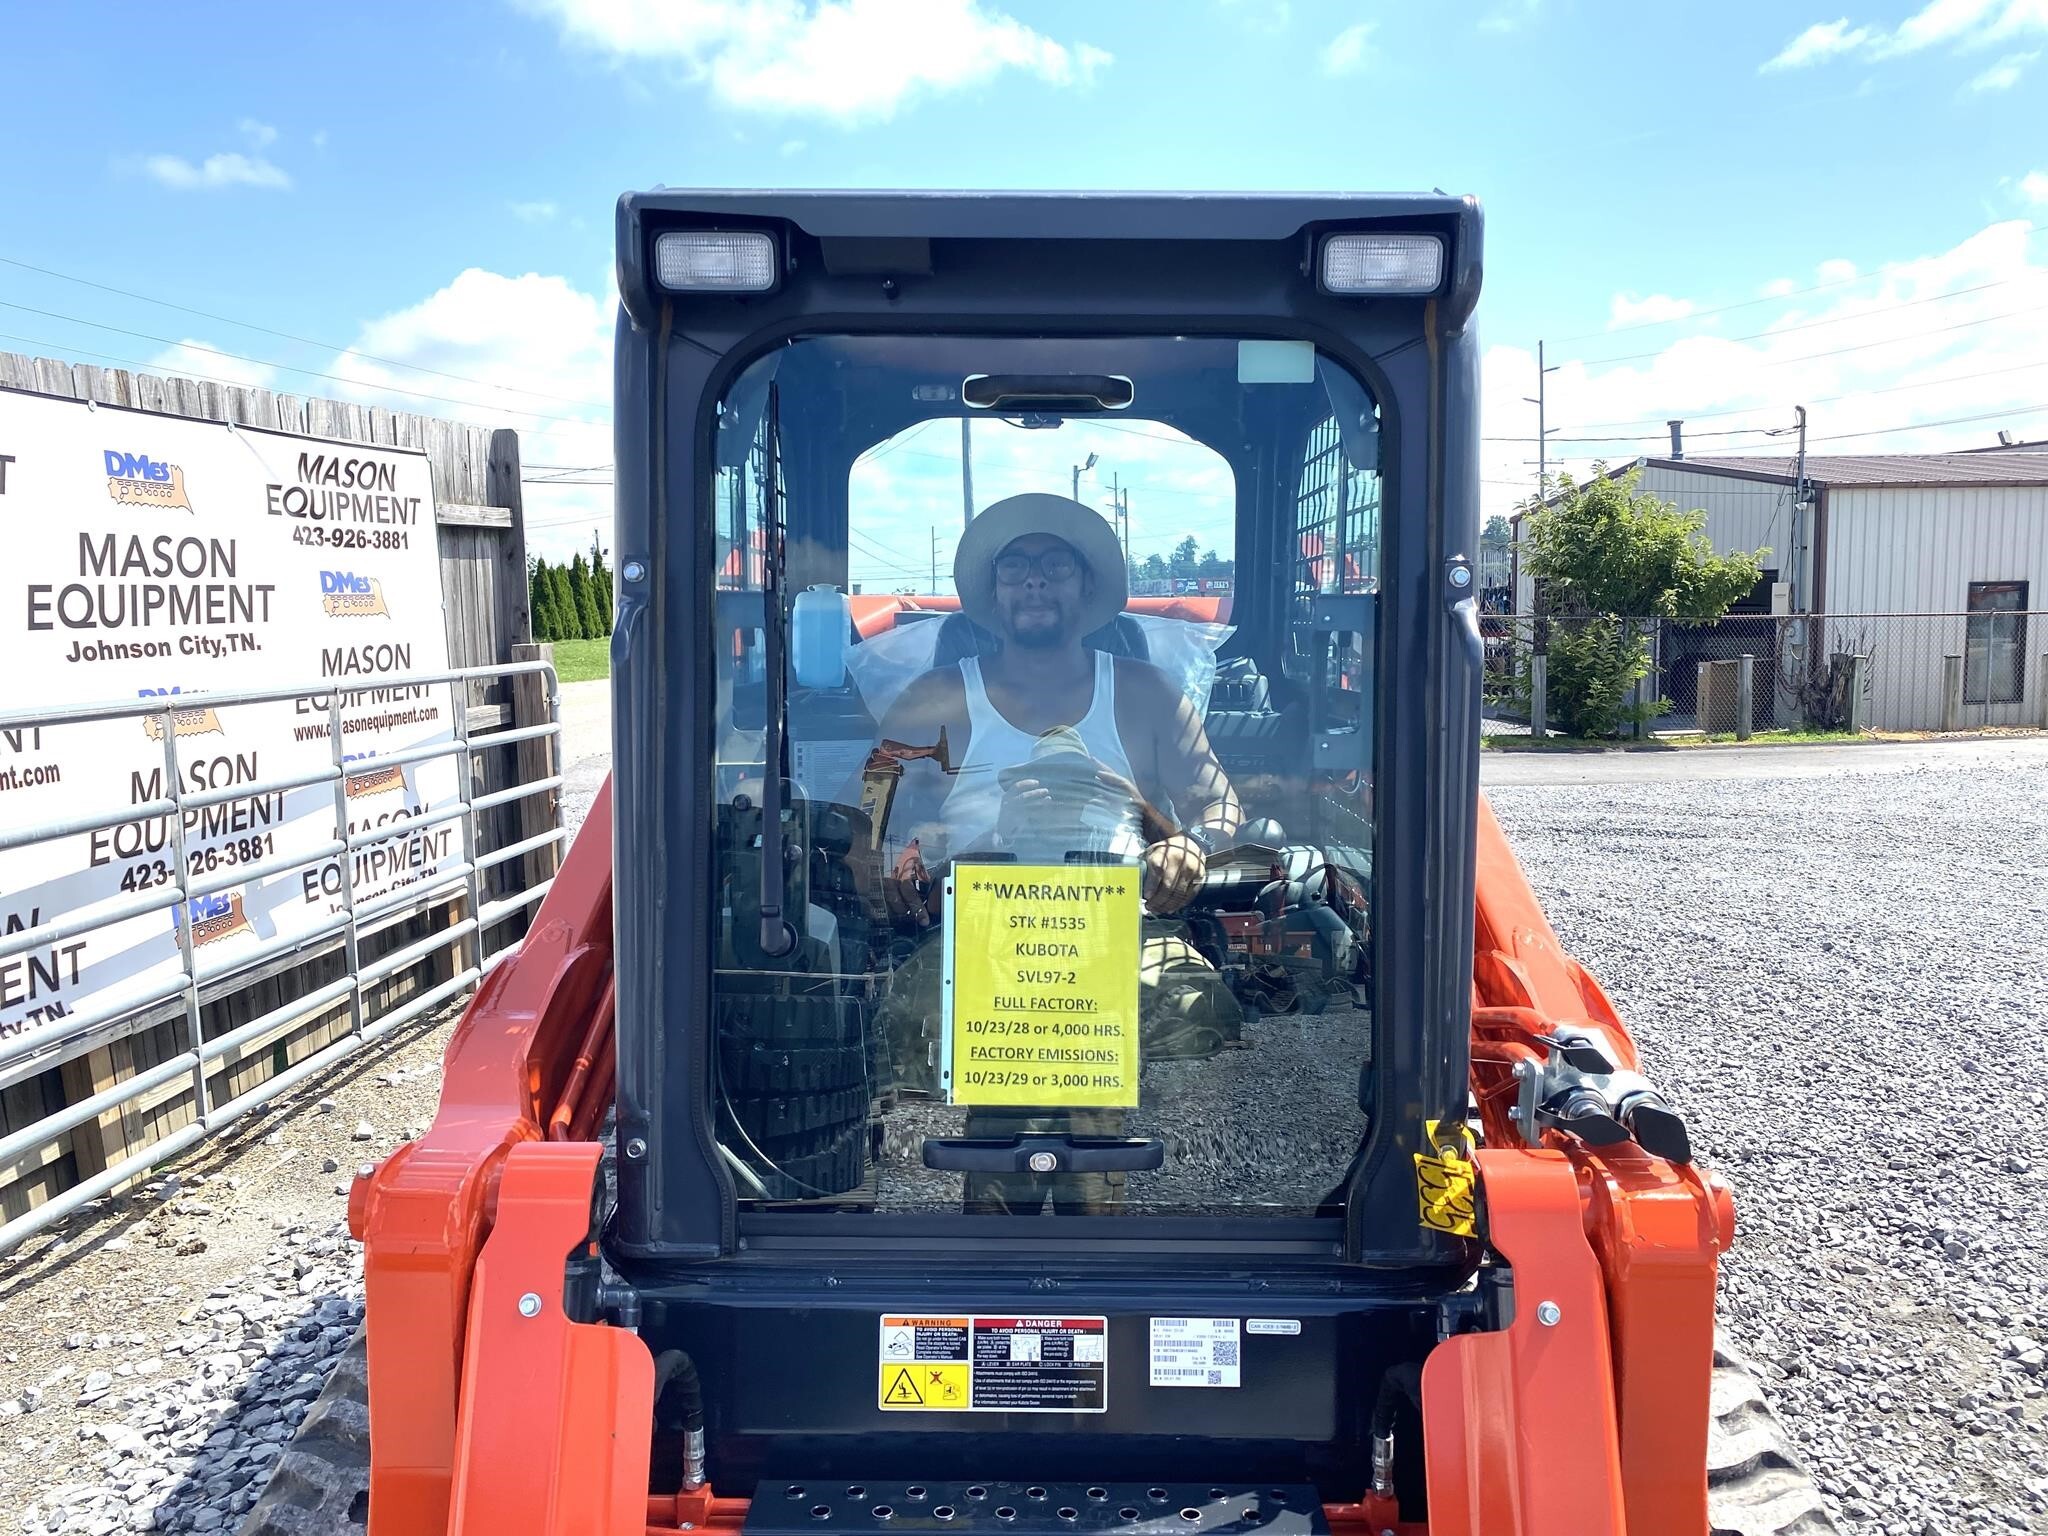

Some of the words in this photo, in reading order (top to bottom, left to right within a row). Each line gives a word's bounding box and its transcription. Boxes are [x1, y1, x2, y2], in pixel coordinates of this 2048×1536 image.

[298, 452, 396, 492] MASON
[266, 484, 420, 525] EQUIPMENT
[293, 525, 409, 550] 423-926-3881
[79, 532, 236, 578] MASON
[27, 583, 276, 631] EQUIPMENT
[66, 640, 172, 663] Johnson
[322, 643, 411, 677] MASON
[294, 706, 438, 742] www.asonequipment.com
[90, 790, 289, 868] EQUPMENT
[1010, 916, 1036, 929] STK
[1041, 917, 1086, 930] #1535
[1016, 943, 1079, 957] KUBOTA
[1017, 970, 1076, 984] SVL97-2
[994, 996, 1026, 1009] FULL
[1030, 998, 1098, 1011] FACTORY:
[966, 1020, 1030, 1036] 10/23/28
[1034, 1025, 1048, 1035] or
[1052, 1024, 1090, 1037] 4,000
[1094, 1025, 1125, 1037] HRS.
[970, 1046, 1034, 1060] FACTORY
[1038, 1048, 1119, 1062] EMISSIONS:
[965, 1071, 1028, 1086] 10/23/29
[1033, 1076, 1047, 1085] or
[1051, 1074, 1089, 1088] 3,000
[1092, 1076, 1124, 1088] HRS.
